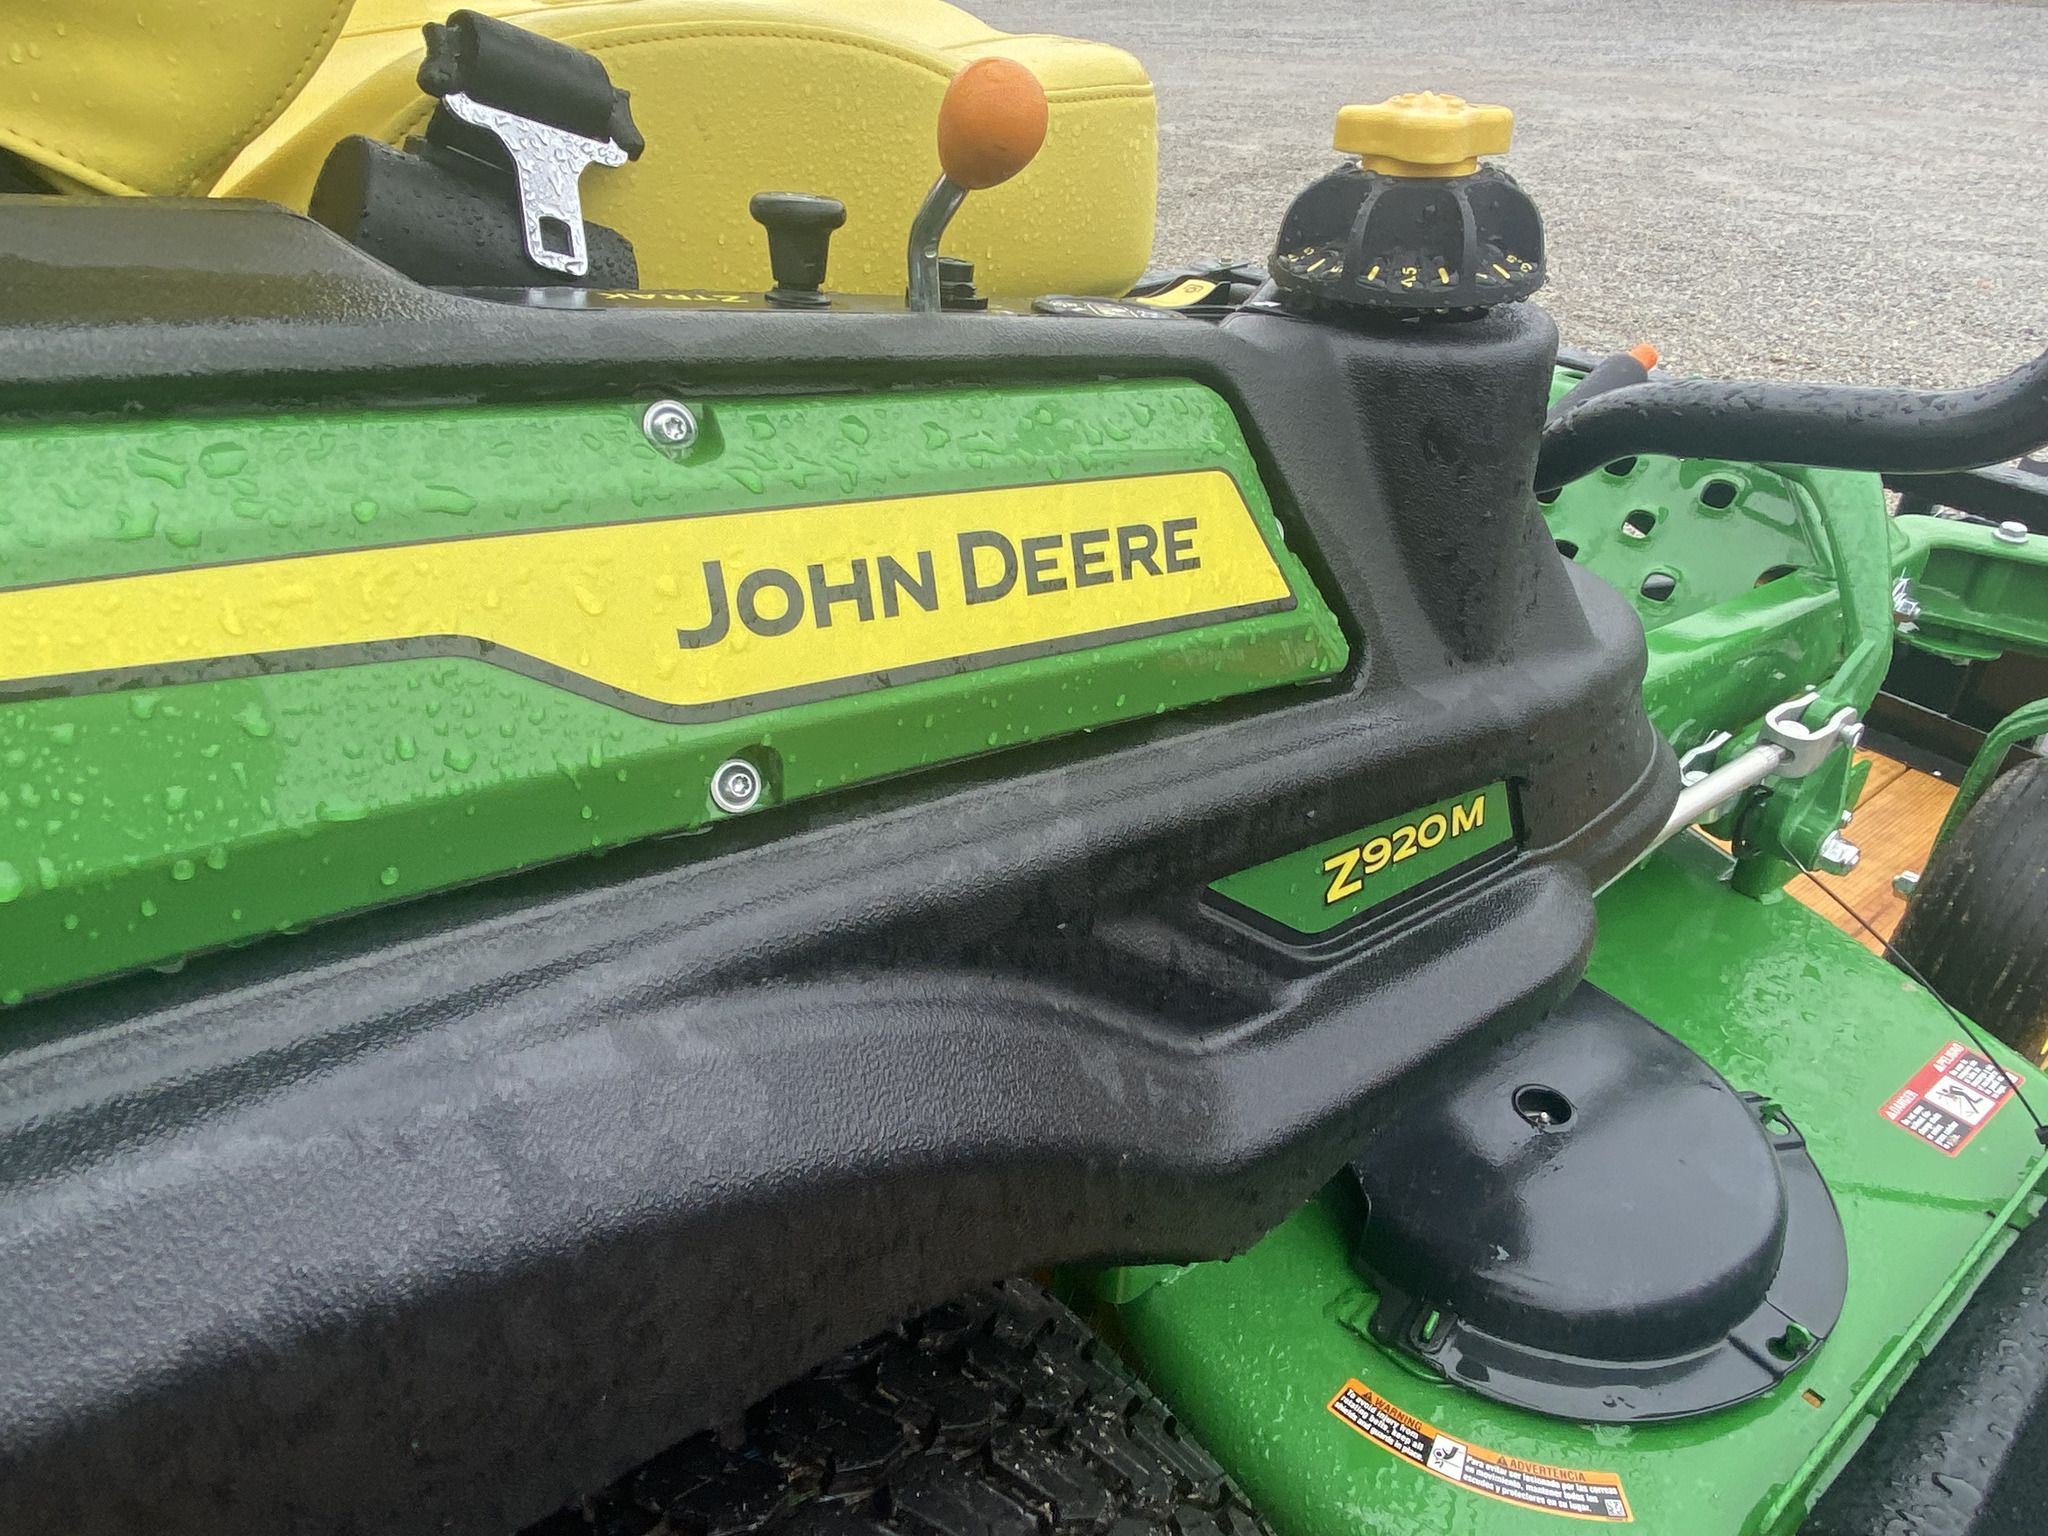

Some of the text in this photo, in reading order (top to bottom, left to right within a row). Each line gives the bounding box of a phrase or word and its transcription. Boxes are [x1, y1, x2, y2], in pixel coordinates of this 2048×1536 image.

[676, 517, 1201, 649] JOHN DEERE
[1323, 795, 1486, 904] Z920M
[1888, 1088, 1919, 1115] DANGER
[1333, 1401, 1358, 1421] shields
[1356, 1418, 1372, 1431] and
[1369, 1427, 1394, 1445] guards
[1393, 1441, 1402, 1450] in
[1340, 1395, 1369, 1419] rotating
[1391, 1428, 1412, 1445] keep
[1411, 1440, 1424, 1451] all
[1347, 1388, 1419, 1440] To avoid injury from
[1374, 1397, 1423, 1431] WARNING
[1464, 1465, 1475, 1474] en
[1466, 1455, 1484, 1468] Para
[1485, 1463, 1508, 1475] evitar
[1510, 1460, 1586, 1482] ADVERTENCIA
